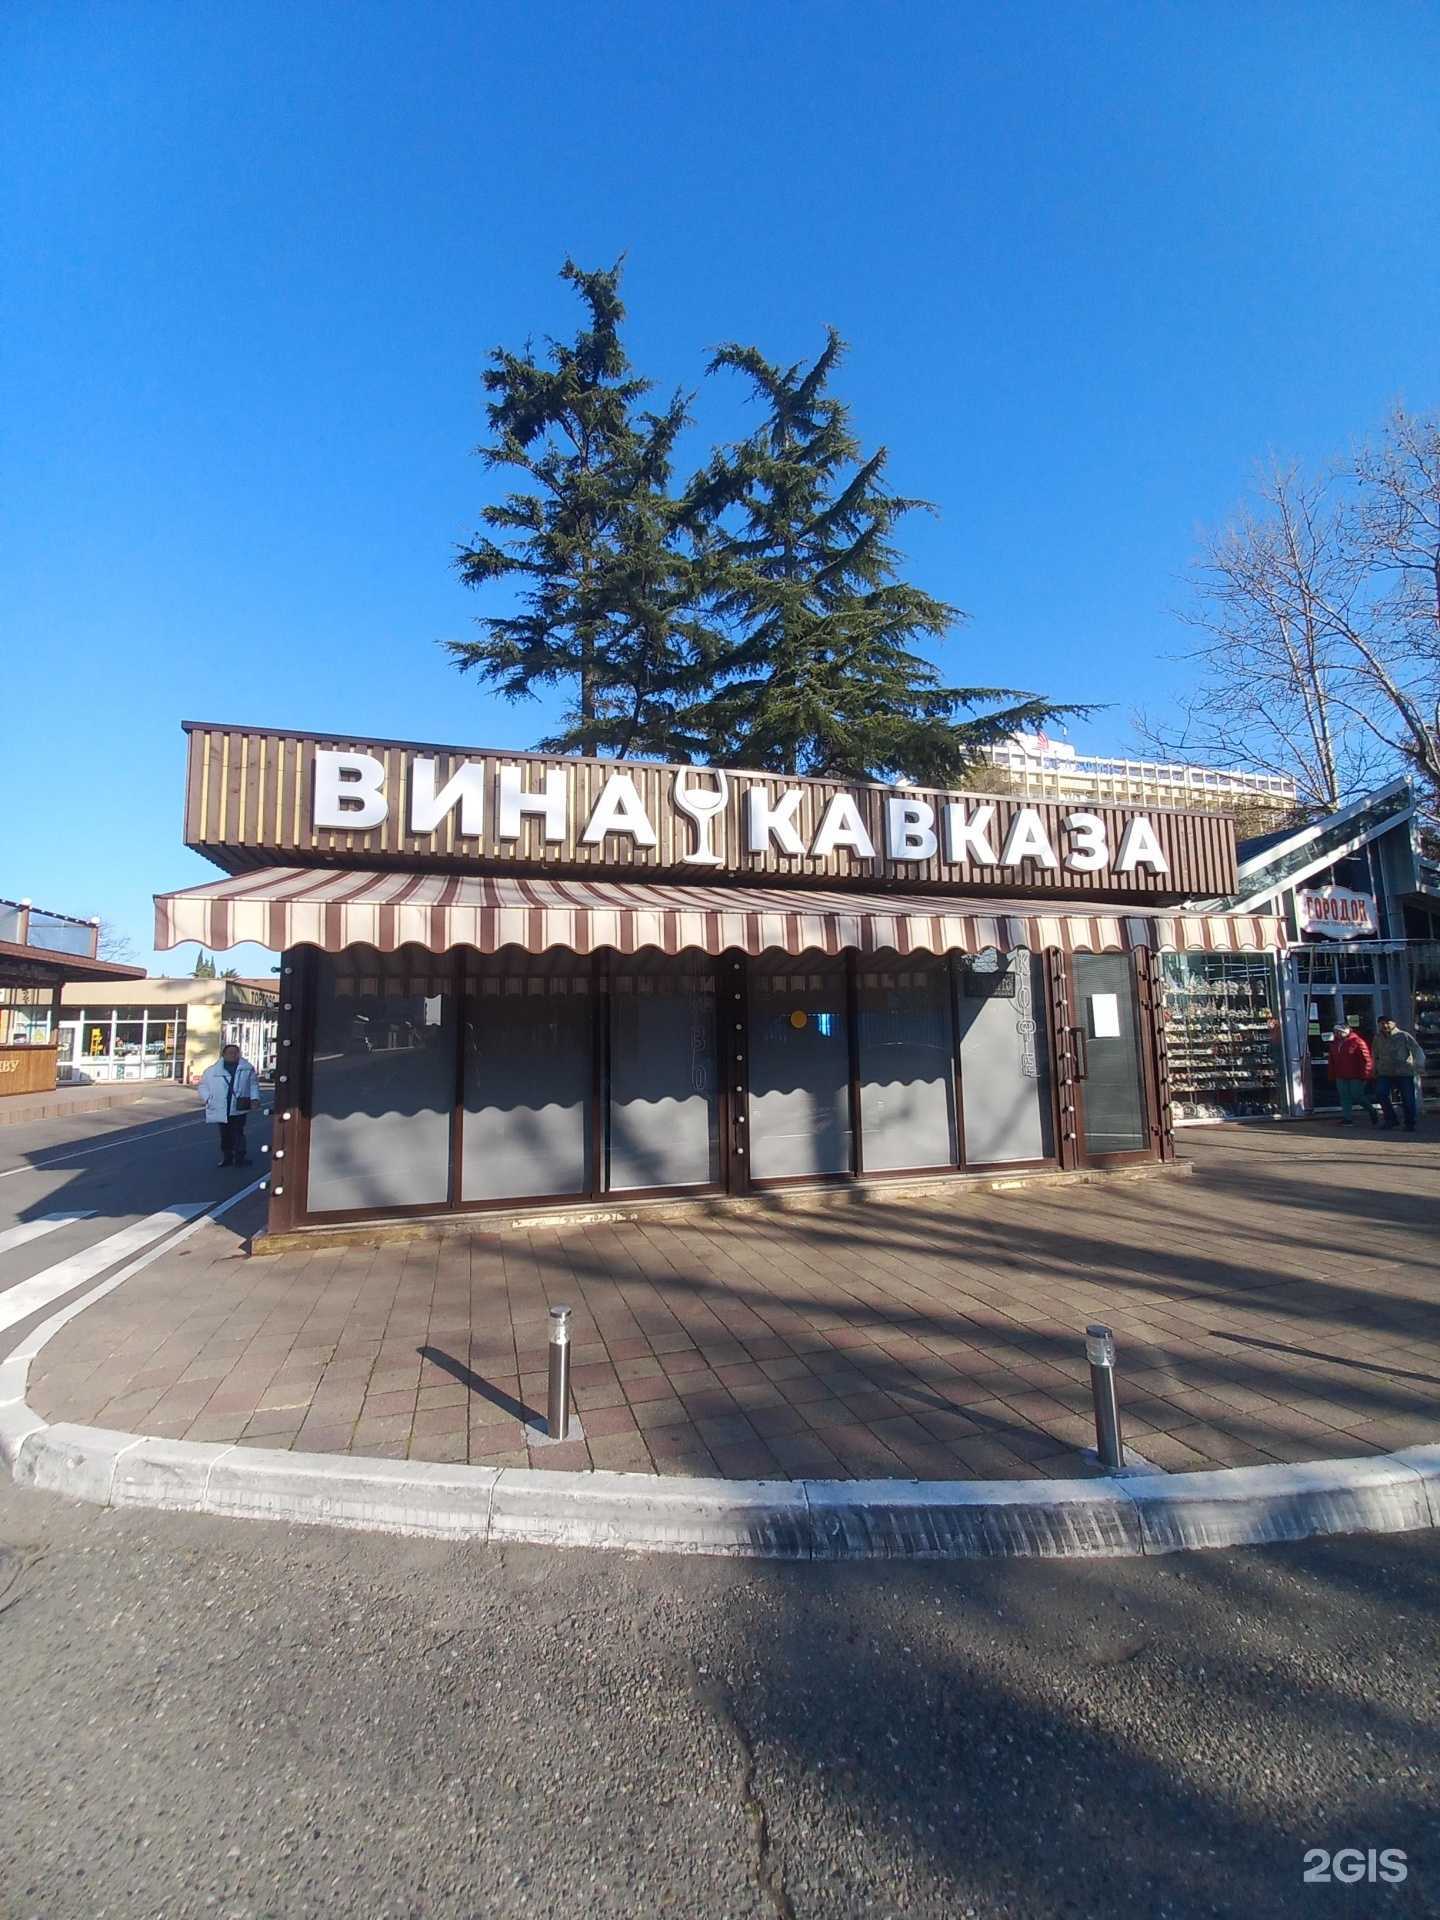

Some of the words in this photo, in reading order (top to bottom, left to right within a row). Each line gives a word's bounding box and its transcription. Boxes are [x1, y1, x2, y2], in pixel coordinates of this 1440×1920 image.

[313, 749, 657, 847] ВИНА
[746, 786, 1171, 873] КАВКАЗА
[1305, 896, 1369, 922] ГОРОДОК
